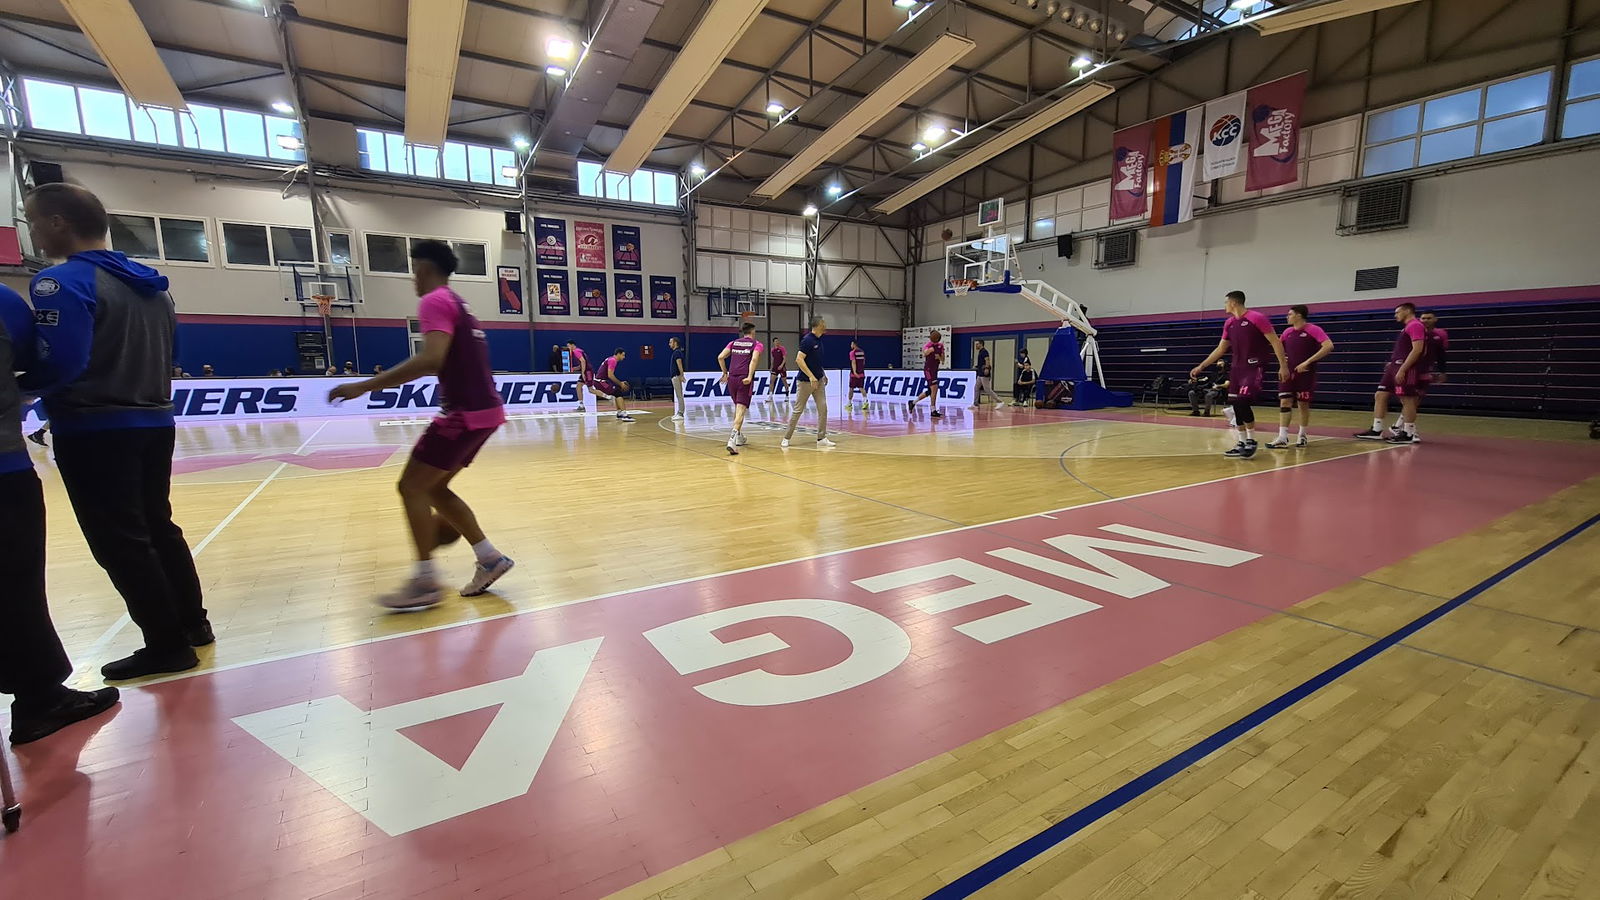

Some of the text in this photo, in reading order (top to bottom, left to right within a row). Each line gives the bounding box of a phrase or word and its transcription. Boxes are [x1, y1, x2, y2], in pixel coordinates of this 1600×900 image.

[1253, 109, 1288, 158] MEGA
[1279, 112, 1296, 154] Factory
[1114, 151, 1140, 191] MEGA
[1133, 154, 1145, 188] Factory
[853, 375, 968, 400] KECHERS
[232, 523, 1262, 836] MEGA
